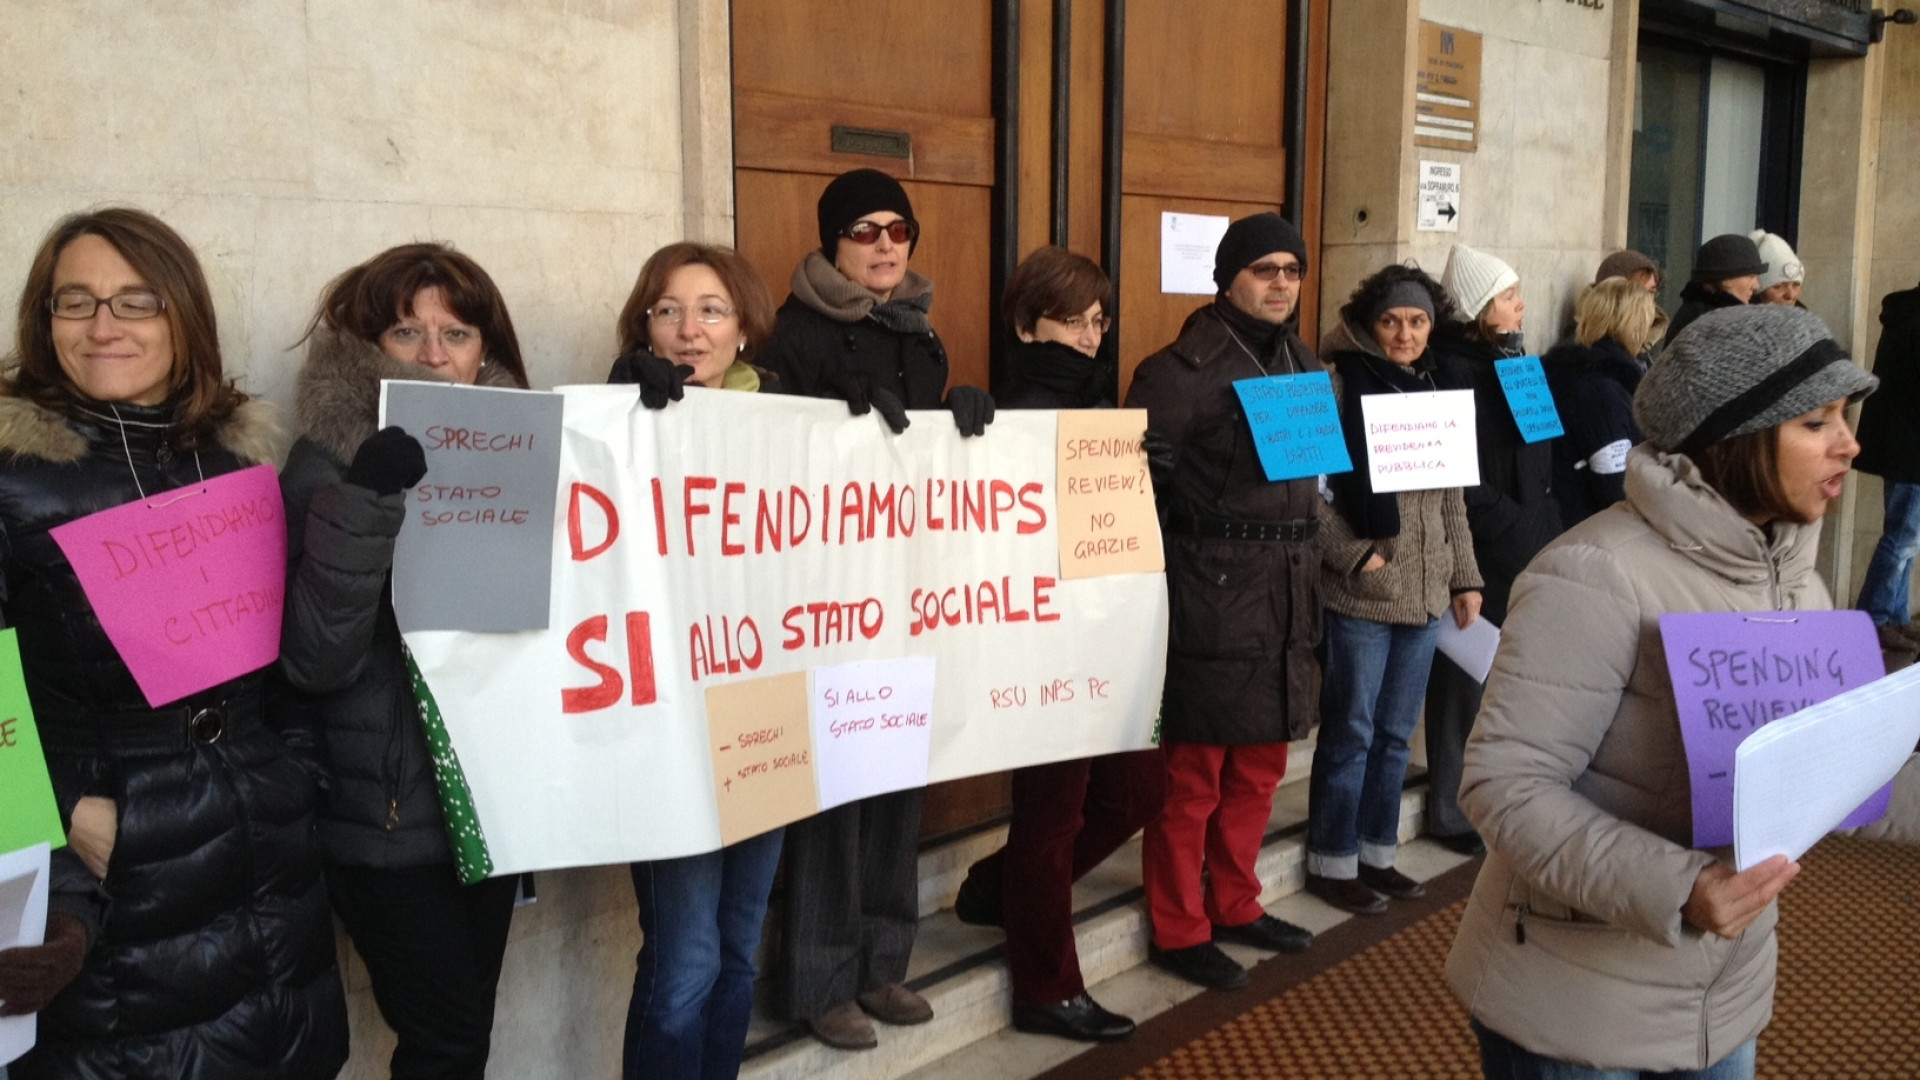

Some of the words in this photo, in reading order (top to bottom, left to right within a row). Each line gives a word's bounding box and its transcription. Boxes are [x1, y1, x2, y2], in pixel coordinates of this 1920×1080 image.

[425, 425, 534, 451] SPRECHI
[1370, 421, 1439, 435] DIFENDIAMO
[1444, 419, 1457, 429] LA
[1066, 438, 1141, 461] SPENDING
[1373, 439, 1443, 454] PREVIDENZA
[1378, 460, 1446, 474] PUBBLICA
[418, 485, 502, 502] STATO
[1068, 469, 1146, 495] REVIEW?
[422, 508, 529, 526] SOCIALE
[567, 476, 916, 561] DIFENDIAMO
[926, 478, 1047, 535] L'INPS
[1090, 512, 1115, 533] NO
[102, 496, 275, 581] DIFENDIAMO
[1074, 536, 1140, 560] GRAZIE
[200, 564, 209, 584] I
[561, 611, 656, 714] SI
[690, 614, 763, 681] ALLO
[782, 597, 884, 650] STATO
[909, 576, 1061, 637] SOCIALE
[1688, 647, 1844, 690] SPENDING
[824, 687, 840, 708] SI
[846, 685, 893, 704] ALLO
[990, 685, 1027, 709] RSU
[1040, 678, 1075, 707] INPS
[1087, 676, 1110, 698] PC
[829, 719, 876, 739] STATO
[881, 712, 928, 730] SOCIALE
[1702, 697, 1814, 732] REVIE
[738, 726, 784, 749] SPRECHI
[737, 761, 768, 779] STATO
[773, 750, 809, 771] SOCIALE
